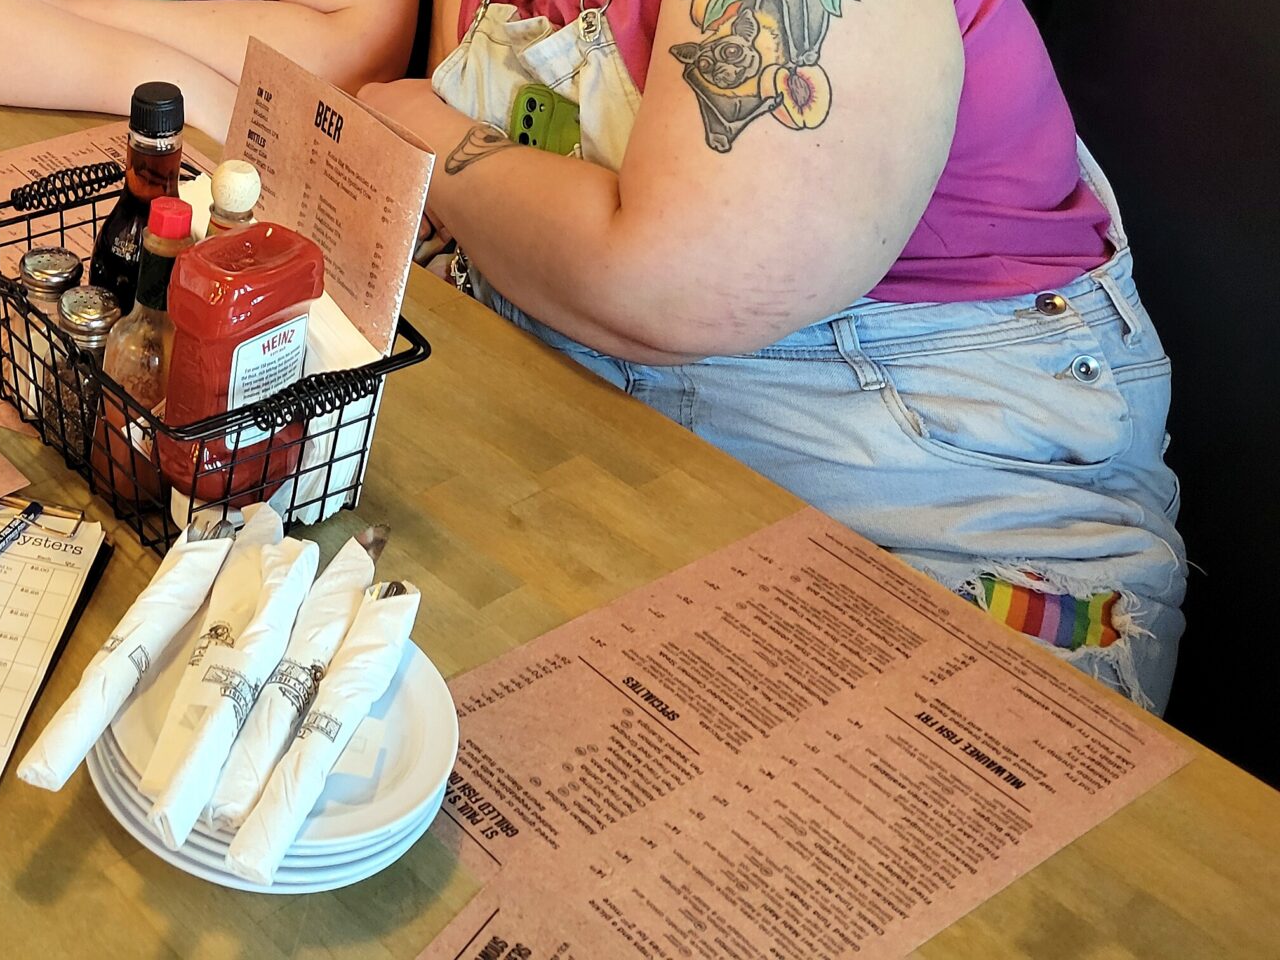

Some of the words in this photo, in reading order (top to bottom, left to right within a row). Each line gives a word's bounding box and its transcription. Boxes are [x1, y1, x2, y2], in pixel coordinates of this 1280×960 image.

[314, 100, 343, 143] BEER
[247, 128, 266, 148] BOTTLES
[261, 328, 296, 356] HEINZ
[11, 530, 83, 556] ysters
[622, 676, 679, 720] SPECIALTIES
[914, 711, 938, 727] FRY
[934, 725, 963, 744] FISH
[960, 742, 1025, 789] MILWAUKEE
[456, 782, 483, 804] FISH
[477, 802, 518, 837] GRILLED
[901, 816, 934, 841] Grouper
[814, 842, 851, 873] Swordfish
[899, 845, 932, 871] Grouper
[934, 841, 977, 874] Blackened
[815, 878, 834, 893] Melt
[853, 873, 867, 887] Jerk
[878, 861, 909, 887] Walleye
[932, 871, 955, 889] Fried
[834, 893, 853, 911] Tuna
[871, 888, 908, 919] Jamaican
[909, 886, 932, 904] Fried
[856, 910, 884, 935] Classic
